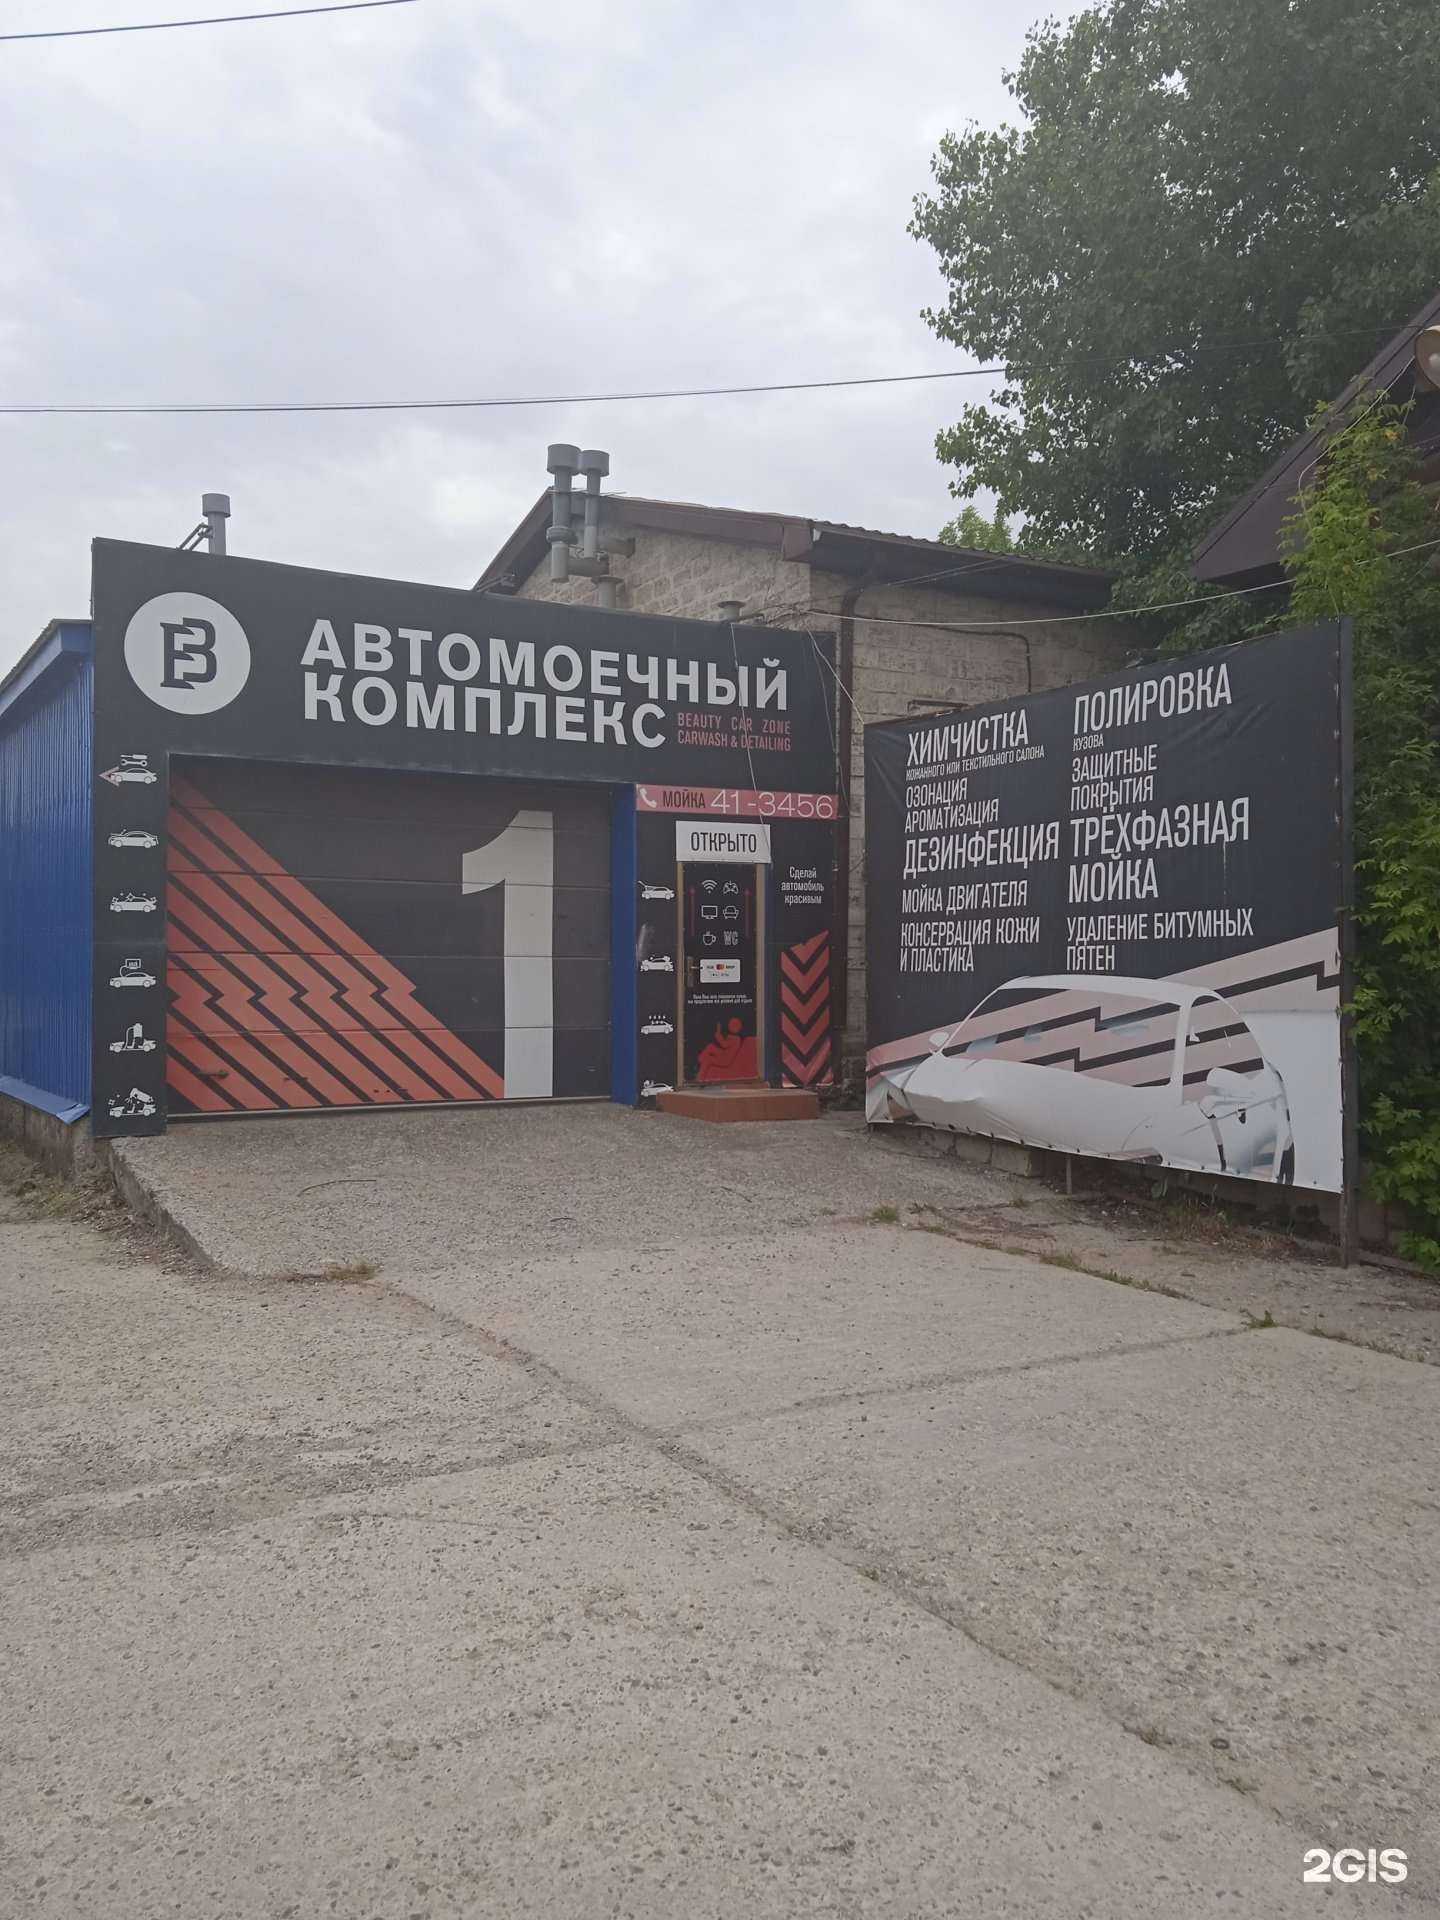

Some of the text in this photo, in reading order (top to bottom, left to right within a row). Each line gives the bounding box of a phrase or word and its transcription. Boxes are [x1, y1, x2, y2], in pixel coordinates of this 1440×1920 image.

[300, 618, 787, 711] АВТОМОЕЧНЫЙ
[304, 671, 666, 748] КОМПЛЕКС
[1074, 663, 1232, 735] ПОЛИРОВКА
[678, 712, 791, 735] BEAUTY CAR ZONE
[907, 709, 1029, 767] ХИМЧИСТКА
[678, 729, 791, 751] CARWASH & DETAILING
[1073, 734, 1104, 751] КУЗОВА
[947, 760, 960, 775] ИЛИ
[962, 751, 1014, 771] ТЕКСТИЛЬНОГО
[1016, 745, 1045, 762] САЛОНА
[1072, 744, 1158, 784] ЗАЩИТНЫЕ
[662, 789, 706, 809] МОЙКА
[906, 778, 968, 808] ОЗОНАЦИЯ
[1071, 775, 1154, 811] ПОКРЫТИЯ
[905, 799, 999, 833] АРОМАТИЗАЦИЯ
[1070, 797, 1249, 857] ТРЁХФАЗНАЯ
[690, 832, 757, 853] ОТКРЫТО
[903, 822, 1060, 880] ДЕЗИНФЕКЦИЯ
[781, 881, 825, 892] автомобиль
[789, 866, 817, 879] Сделай
[1068, 852, 1159, 904] МОЙКА
[784, 893, 822, 905] красивым
[902, 880, 1028, 915] МОЙКА ДВИГАТЕЛЯ
[901, 916, 1041, 947] КОНСЕРВАЦИЯ КОЖИ
[1066, 908, 1254, 946] УДАЛЕНИЕ БИТУМНЫХ
[463, 810, 554, 1099] 1
[900, 945, 975, 973] И ПЛАСТИКА
[1066, 944, 1116, 971] ПЯТЕН
